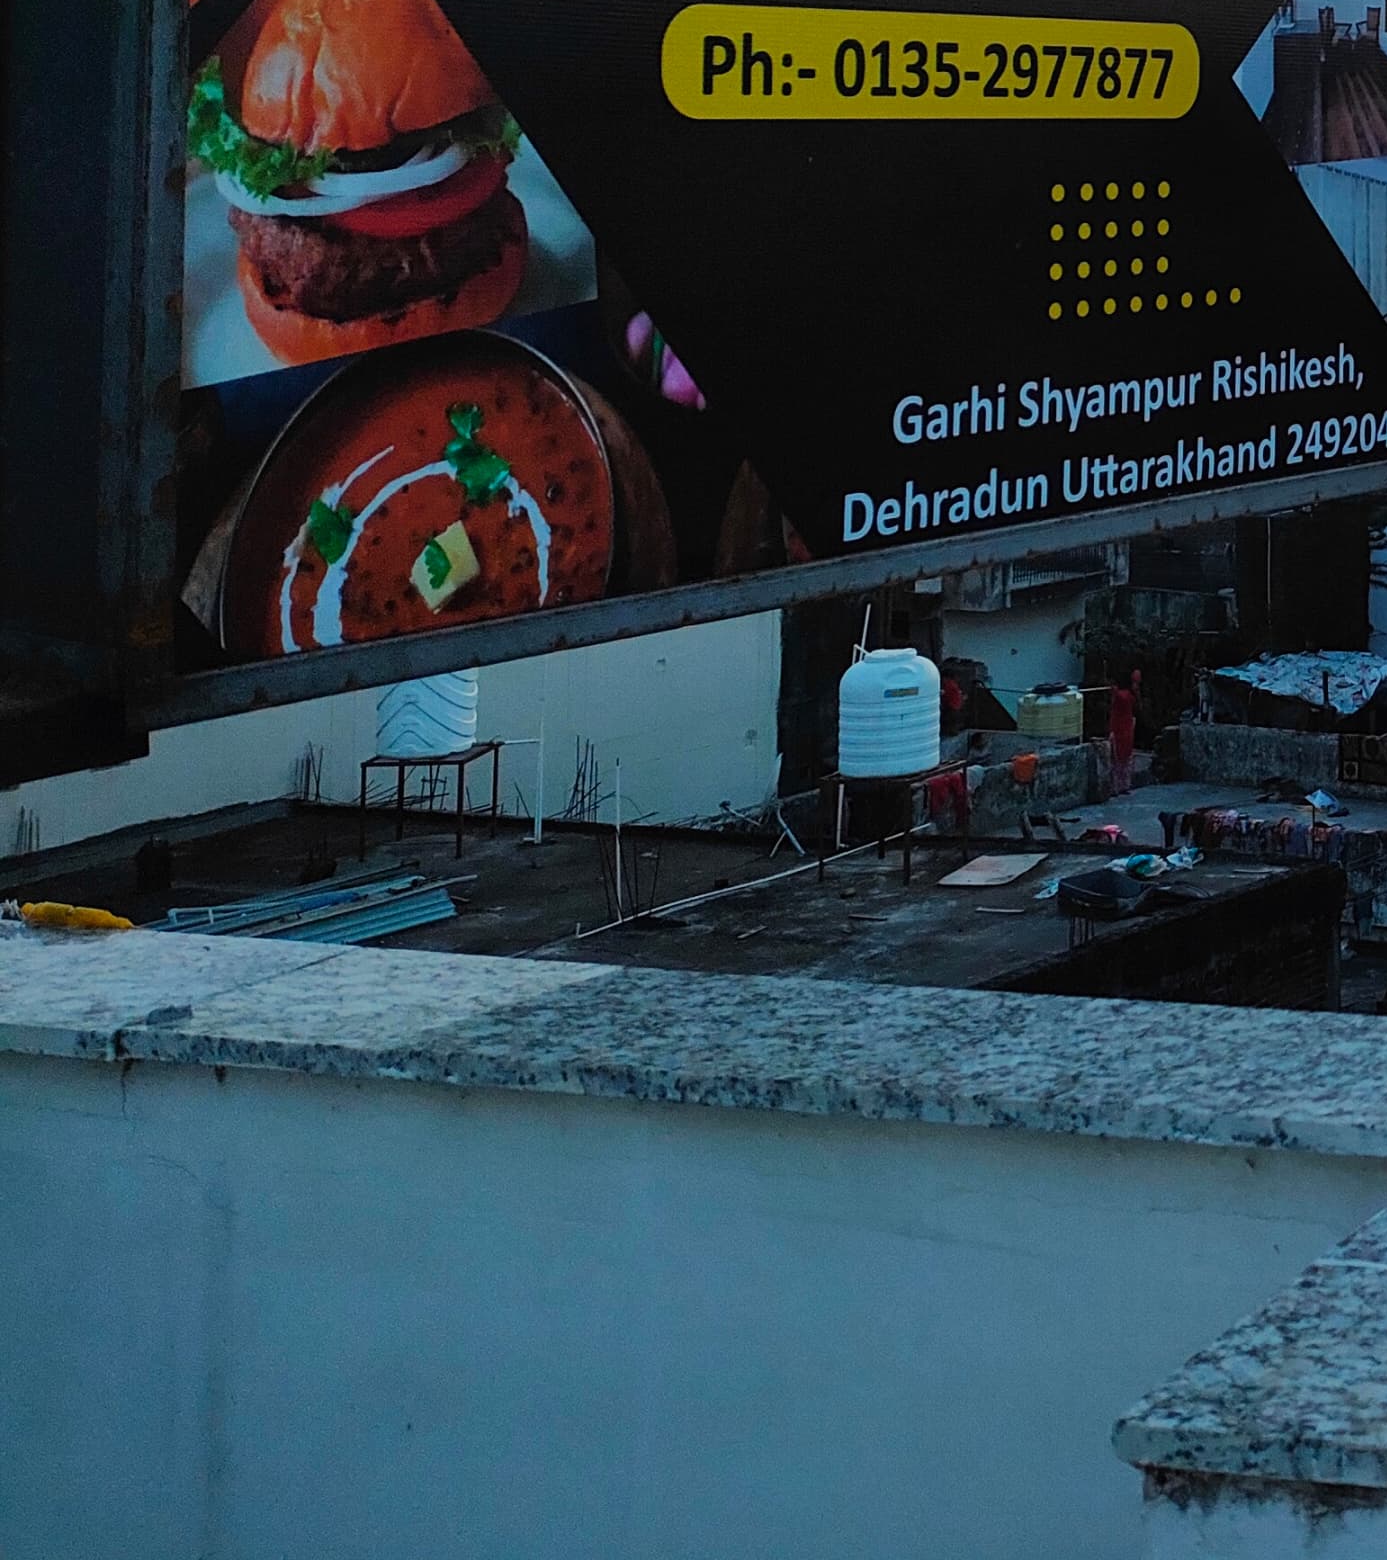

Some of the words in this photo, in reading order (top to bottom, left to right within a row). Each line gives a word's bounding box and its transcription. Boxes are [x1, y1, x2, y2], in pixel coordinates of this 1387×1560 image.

[702, 33, 816, 96] Ph:-
[833, 39, 1173, 100] 0135-2977877
[892, 383, 1005, 444] Garhi
[1018, 369, 1202, 433] Shyampur
[1212, 342, 1364, 402] Rishikesh,
[842, 467, 1048, 542] Dehradun
[1062, 431, 1276, 503] Uttarakhand
